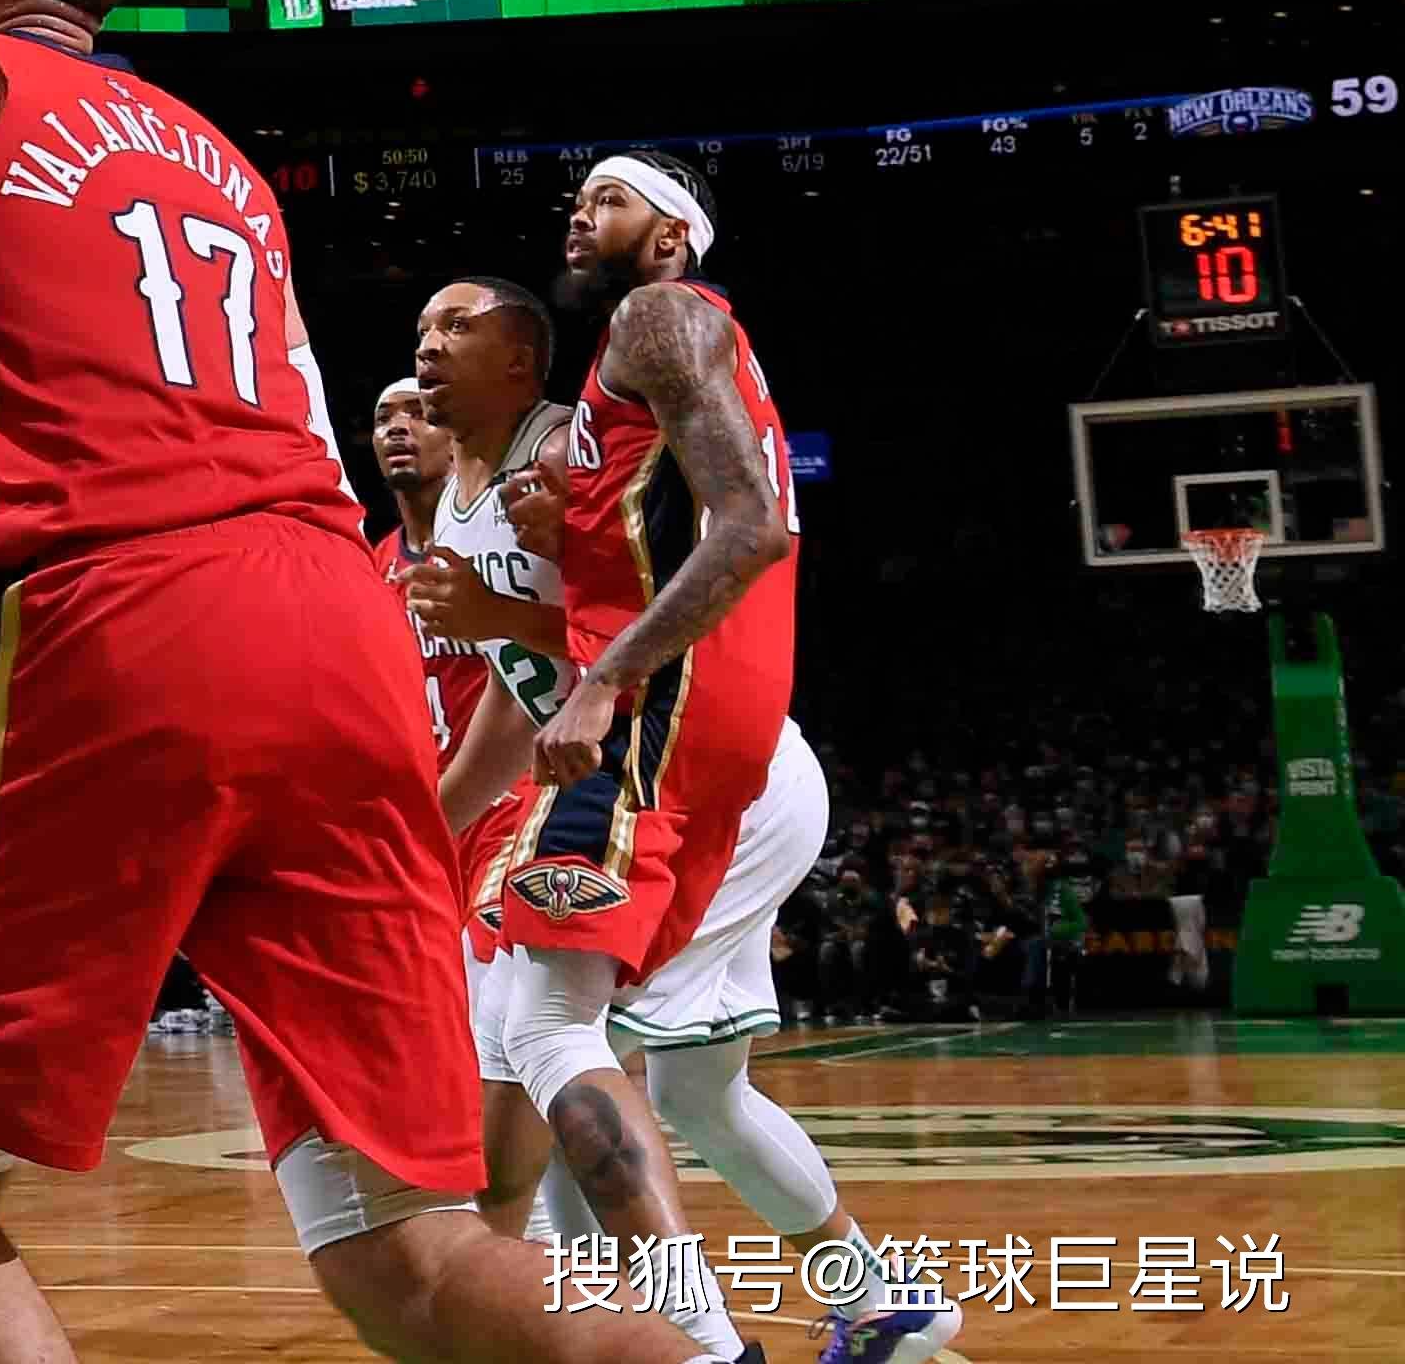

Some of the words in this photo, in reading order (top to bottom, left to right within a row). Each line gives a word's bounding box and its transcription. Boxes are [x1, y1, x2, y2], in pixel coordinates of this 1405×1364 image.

[1169, 96, 1215, 130] NEW
[1219, 86, 1315, 120] ORLEANS
[1330, 75, 1399, 116] 59
[382, 148, 428, 165] 50:50
[494, 150, 528, 165] REB
[559, 146, 595, 161] AST
[885, 128, 913, 143] FG
[982, 116, 1029, 133] FG%
[500, 168, 525, 186] 25
[875, 144, 932, 167] 22/51
[990, 136, 1017, 154] 43
[1079, 128, 1093, 146] 5
[1133, 123, 1148, 141] 2
[1179, 211, 1262, 247] 6:41
[1196, 245, 1258, 304] 10
[113, 199, 261, 408] 17
[1191, 311, 1279, 333] TISSOT
[1309, 946, 1381, 962] balance
